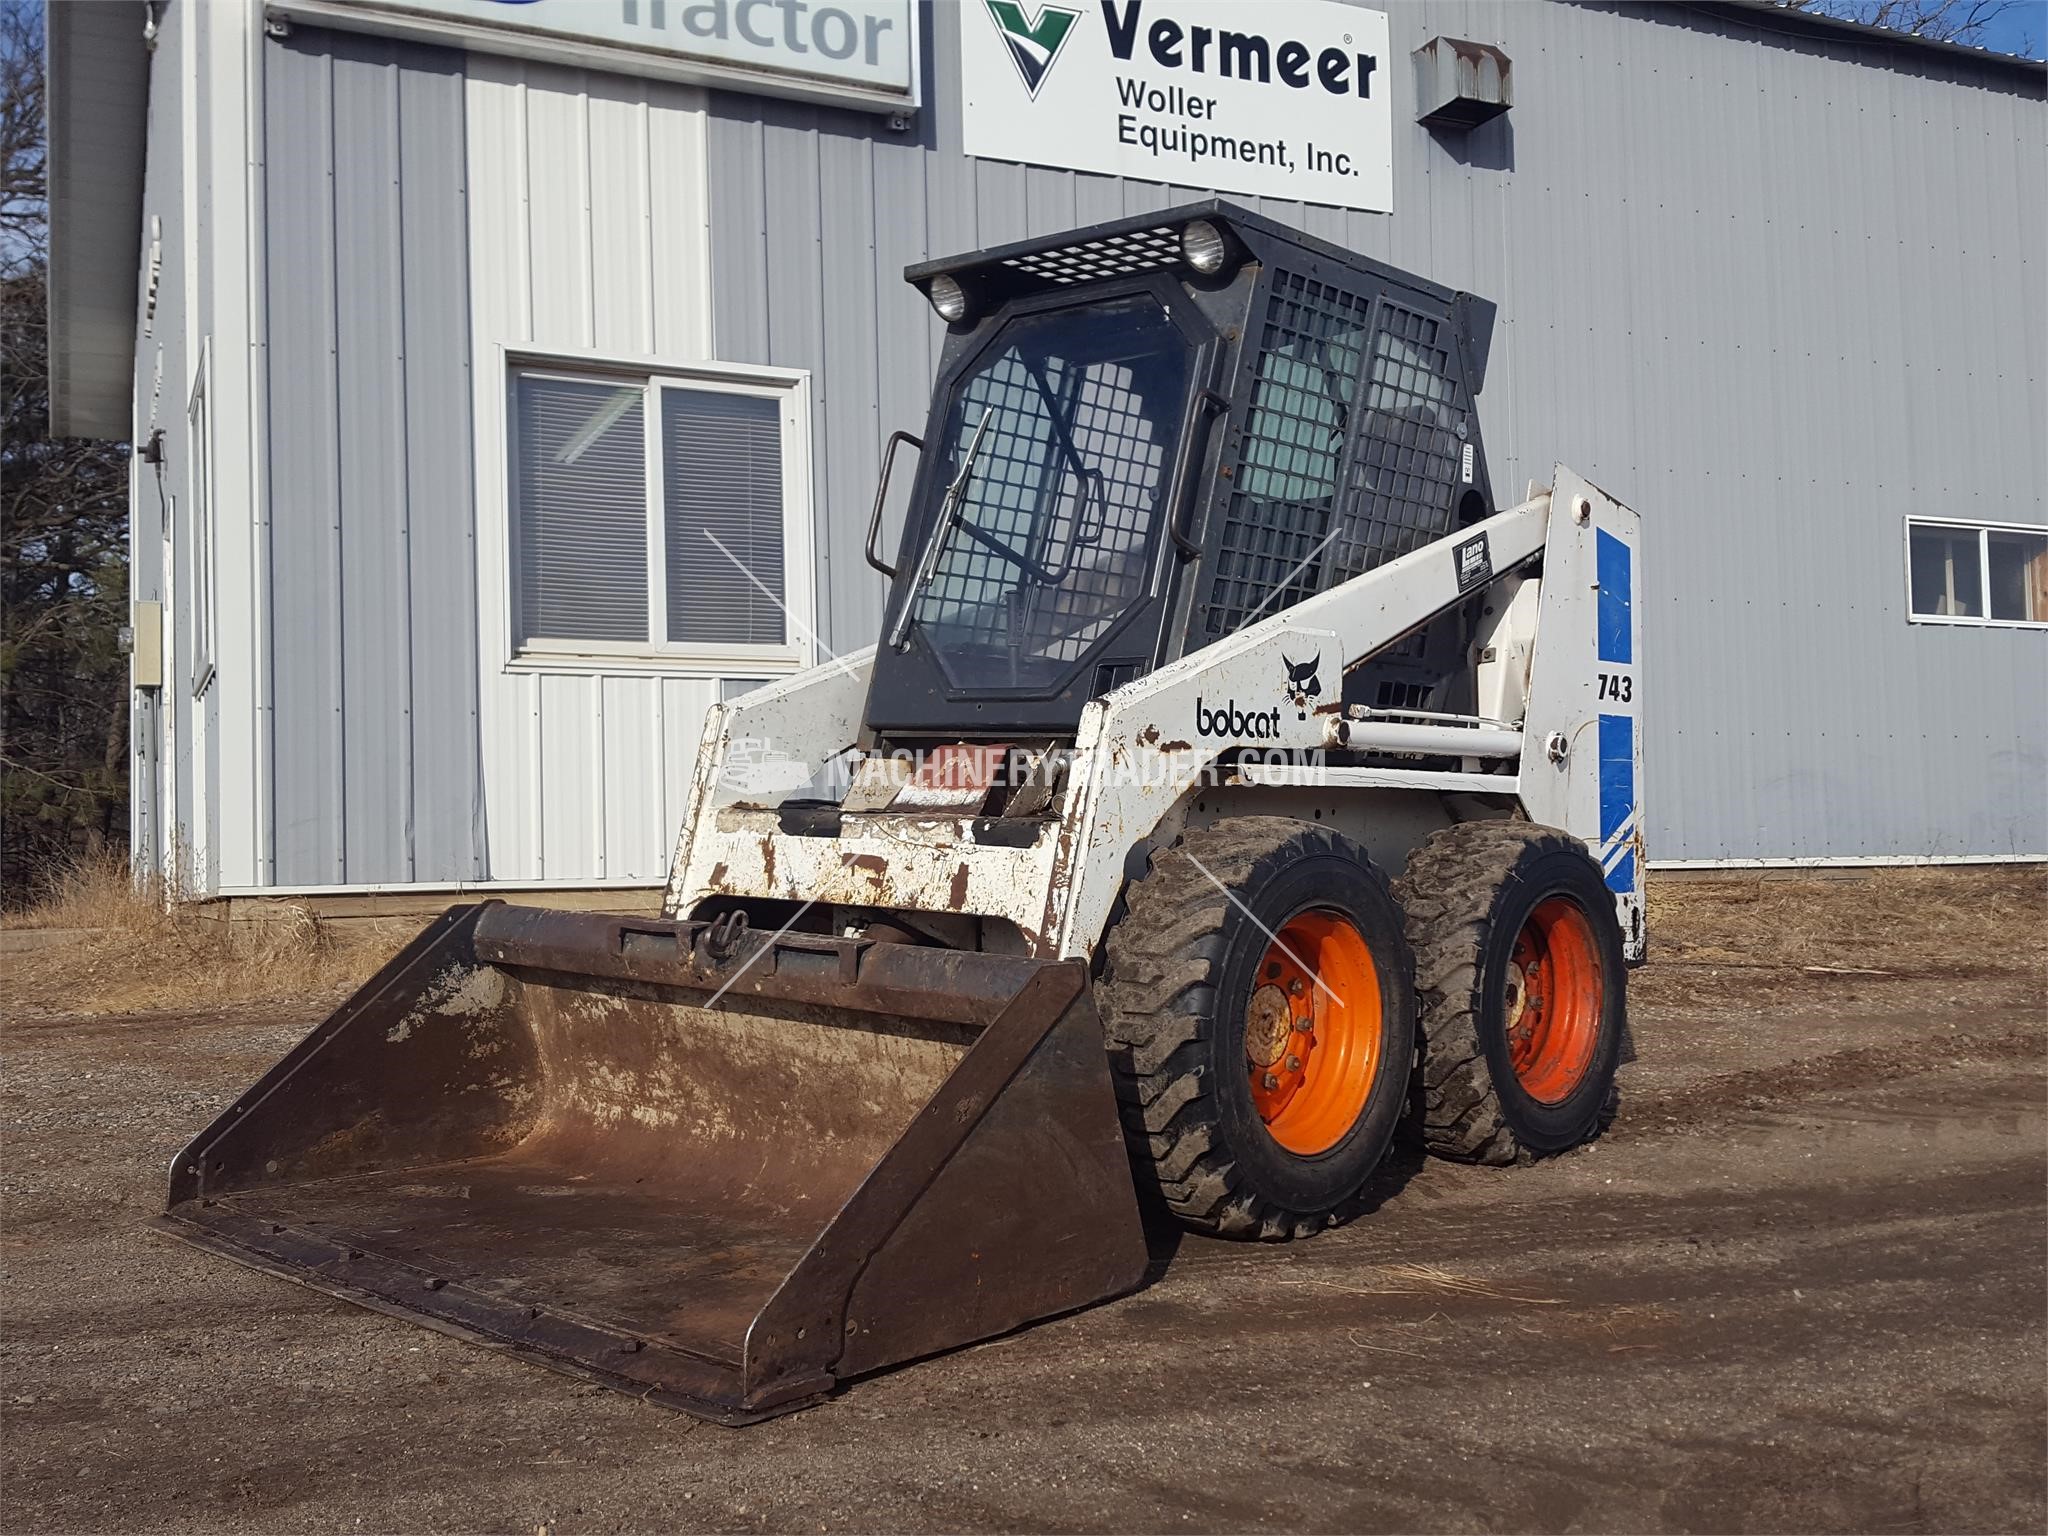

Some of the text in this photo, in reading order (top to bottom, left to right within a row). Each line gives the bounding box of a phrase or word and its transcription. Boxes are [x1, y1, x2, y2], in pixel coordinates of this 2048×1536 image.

[1101, 0, 1377, 99] Vermeer
[1116, 76, 1217, 120] Woller
[1118, 114, 1359, 177] Equipment, Inc.
[1598, 673, 1632, 703] 743
[1196, 697, 1281, 739] bobcat
